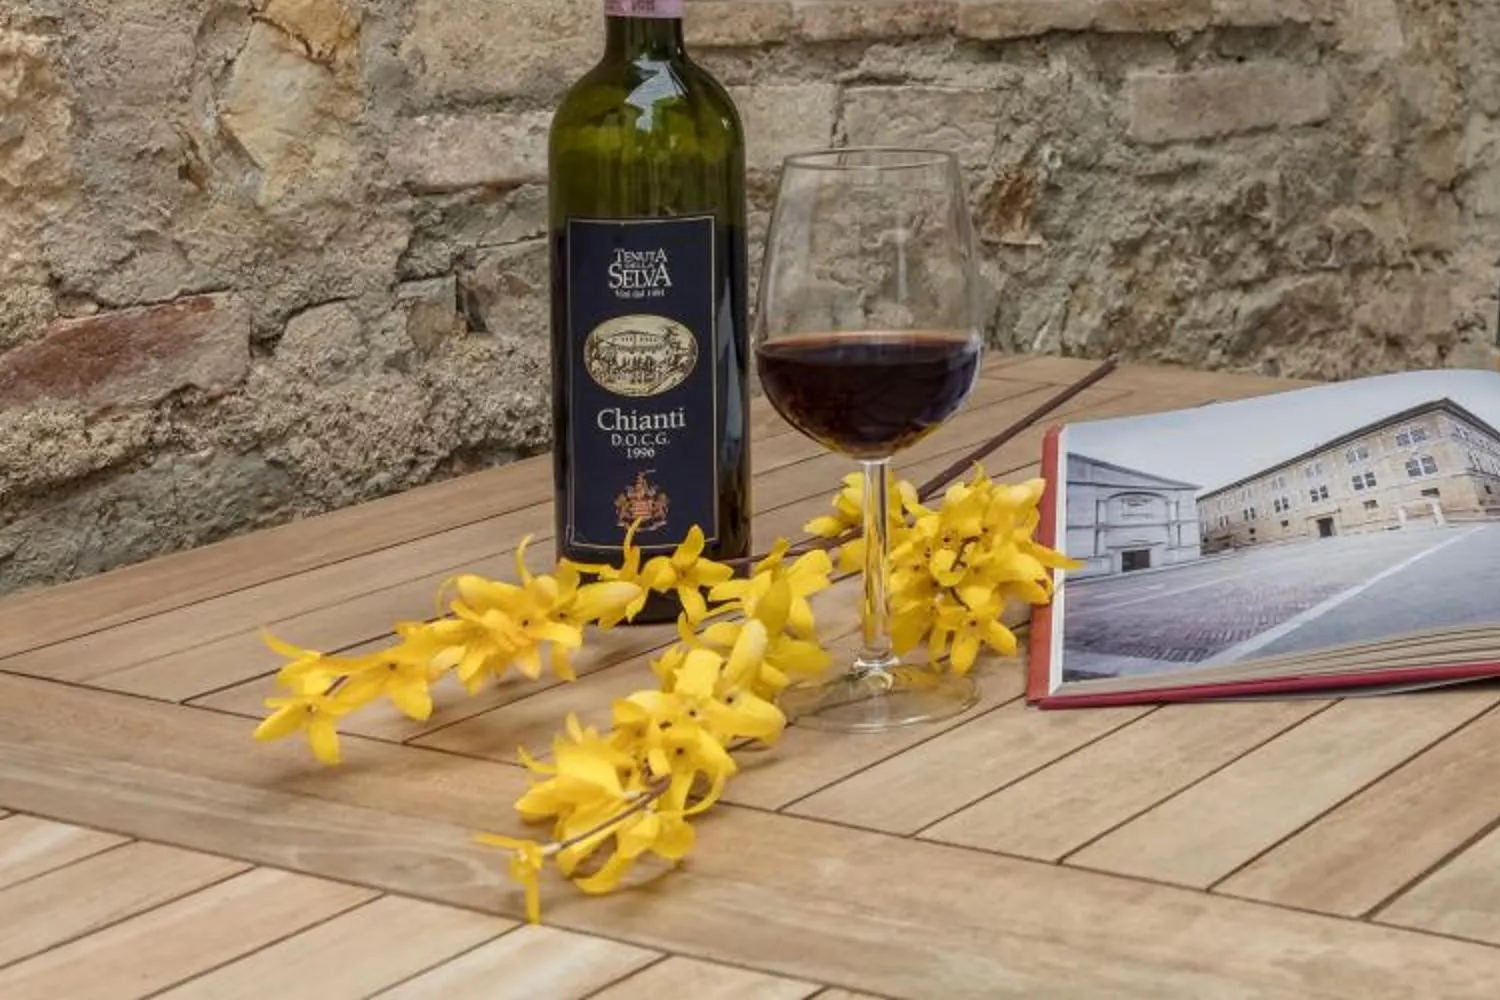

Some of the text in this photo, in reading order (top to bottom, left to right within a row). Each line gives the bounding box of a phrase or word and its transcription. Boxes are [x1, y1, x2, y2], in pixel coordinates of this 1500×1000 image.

[608, 263, 672, 289] SELVA
[597, 408, 686, 431] Chianti
[611, 431, 671, 447] D.O.C.G.
